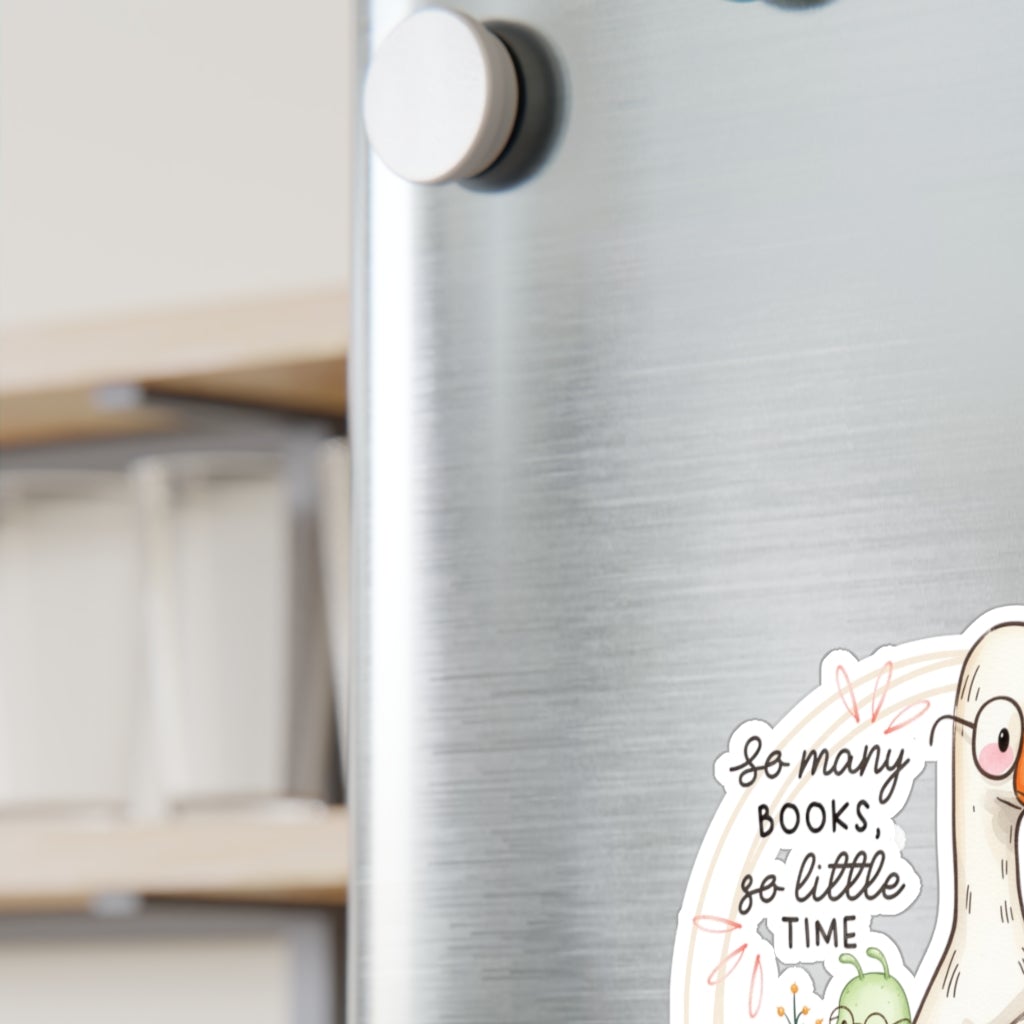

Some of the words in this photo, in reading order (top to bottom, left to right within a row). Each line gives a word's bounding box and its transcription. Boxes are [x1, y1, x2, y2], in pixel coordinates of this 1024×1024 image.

[729, 735, 791, 788] So
[798, 744, 911, 805] many
[757, 798, 882, 840] BOOKS,
[794, 849, 907, 904] little
[781, 914, 858, 950] TIME
